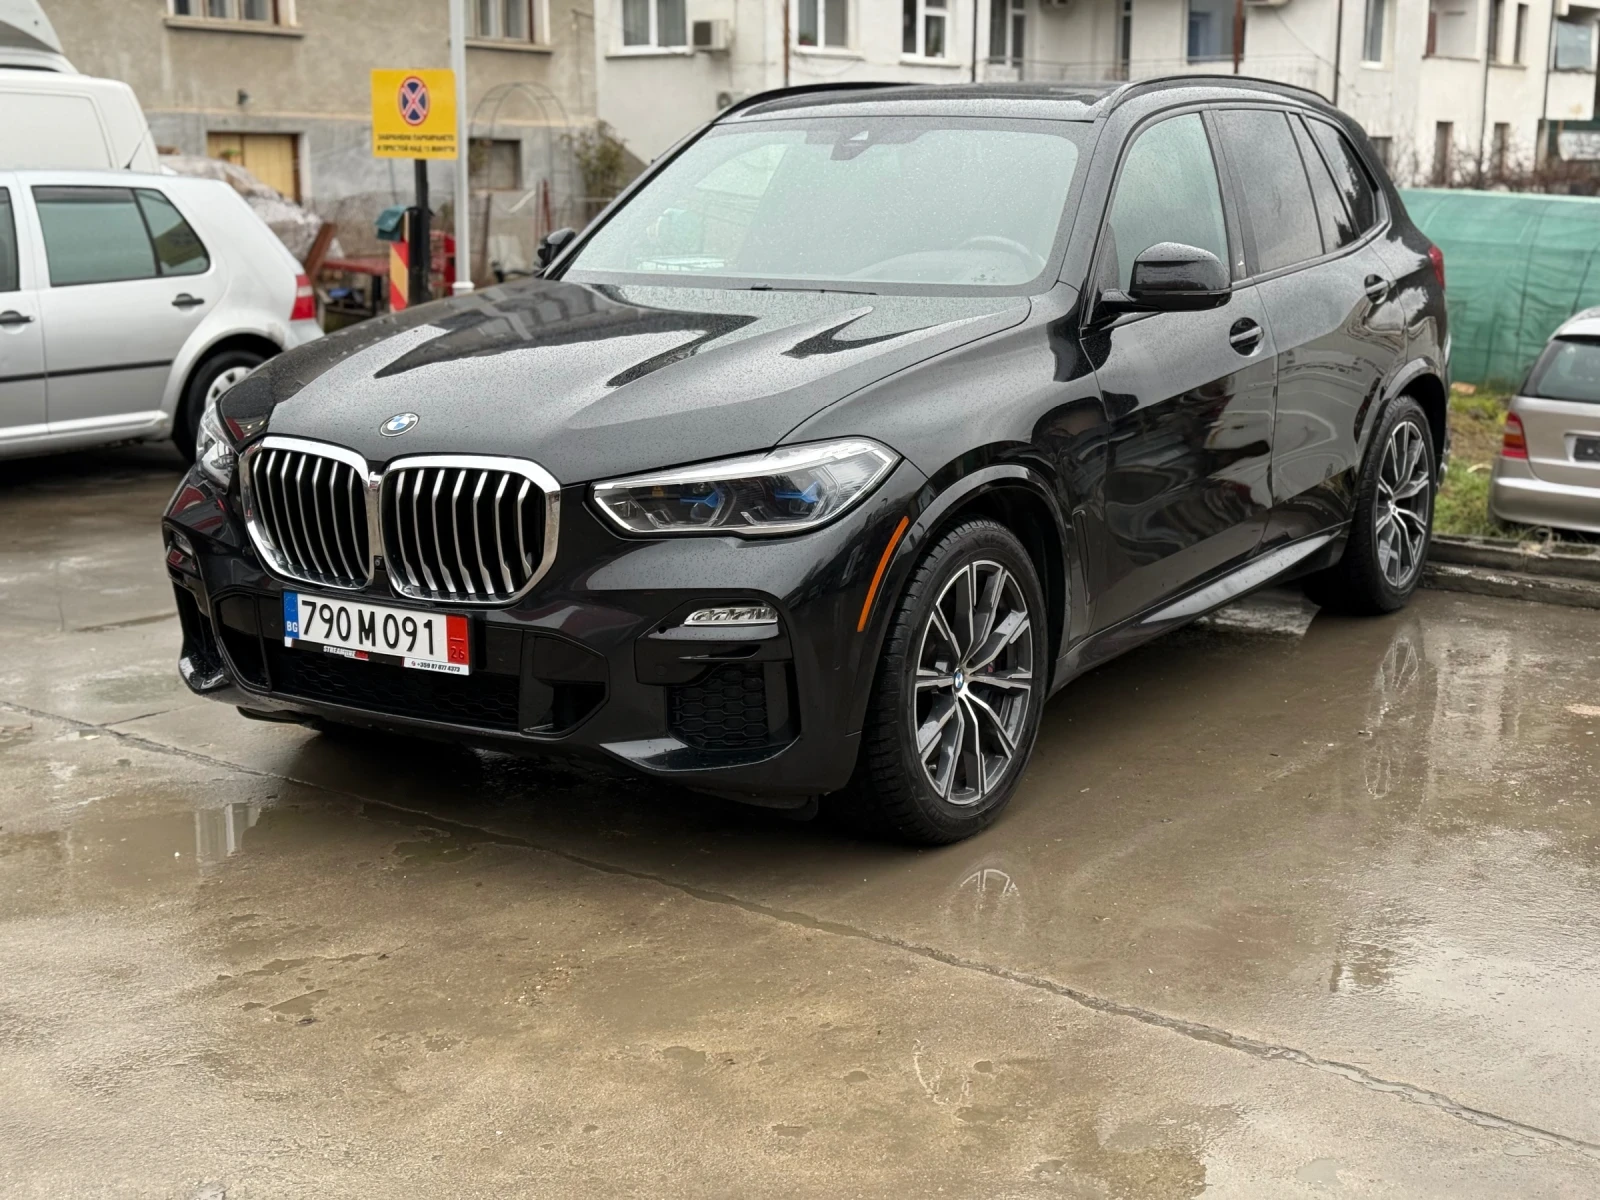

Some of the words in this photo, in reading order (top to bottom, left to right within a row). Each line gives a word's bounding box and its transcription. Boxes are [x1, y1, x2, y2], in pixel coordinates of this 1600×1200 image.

[286, 621, 298, 633] BG
[301, 599, 351, 642] 790
[357, 609, 376, 647] M
[383, 613, 434, 656] 091
[450, 645, 465, 660] 26
